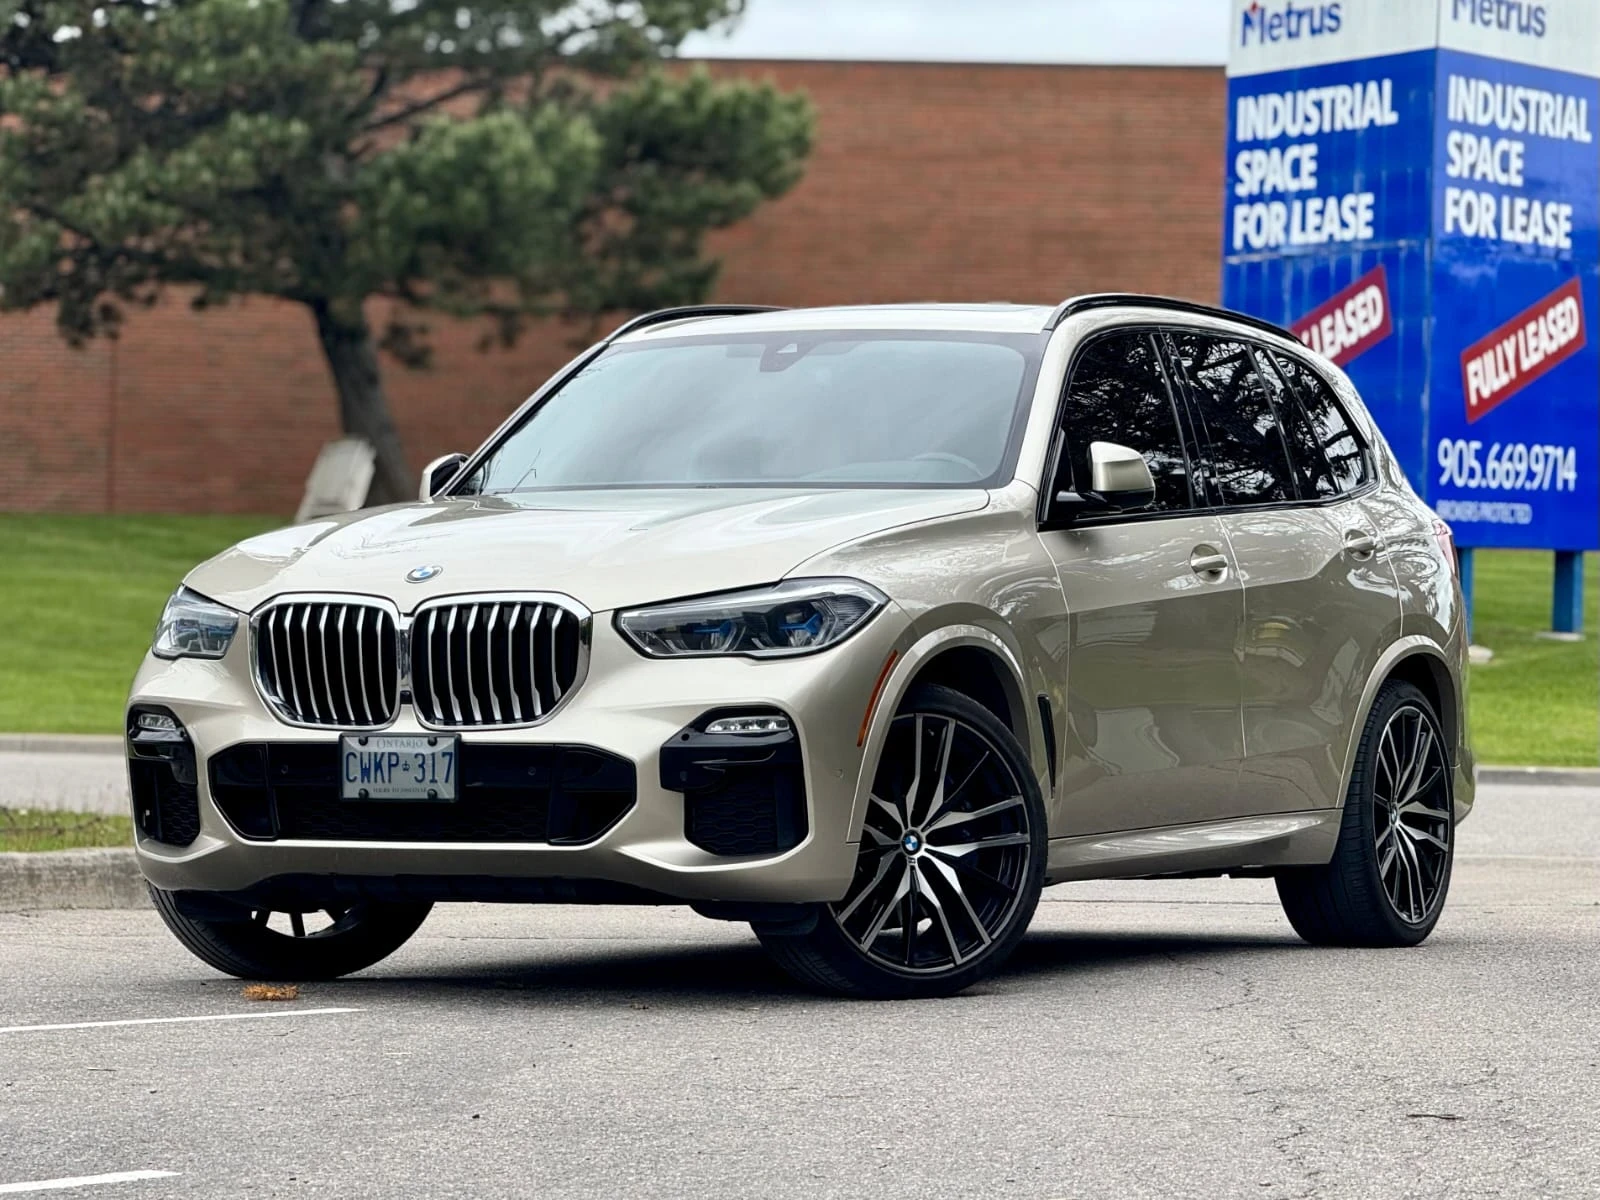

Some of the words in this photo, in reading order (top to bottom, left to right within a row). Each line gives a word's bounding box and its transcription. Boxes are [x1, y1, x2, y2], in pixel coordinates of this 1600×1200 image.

[1241, 3, 1342, 47] Metrus
[1451, 0, 1546, 38] Metrus
[1236, 78, 1399, 143] INDUSTRIAL
[1447, 74, 1592, 143] INDUSTRIAL
[1234, 144, 1318, 197] SPACE
[1446, 130, 1525, 187] SPACE
[1233, 200, 1286, 251] FOR
[1290, 192, 1375, 245] LEASE
[1444, 186, 1498, 240] FOR
[1501, 195, 1573, 249] LEASE
[1310, 284, 1384, 359] LEASED
[1466, 333, 1517, 406] FULLY
[1517, 295, 1580, 371] LEASED
[1437, 438, 1577, 491] 905.669.9714
[345, 751, 400, 784] CWKP
[413, 752, 453, 784] 317
[376, 739, 424, 749] ONTARIO
